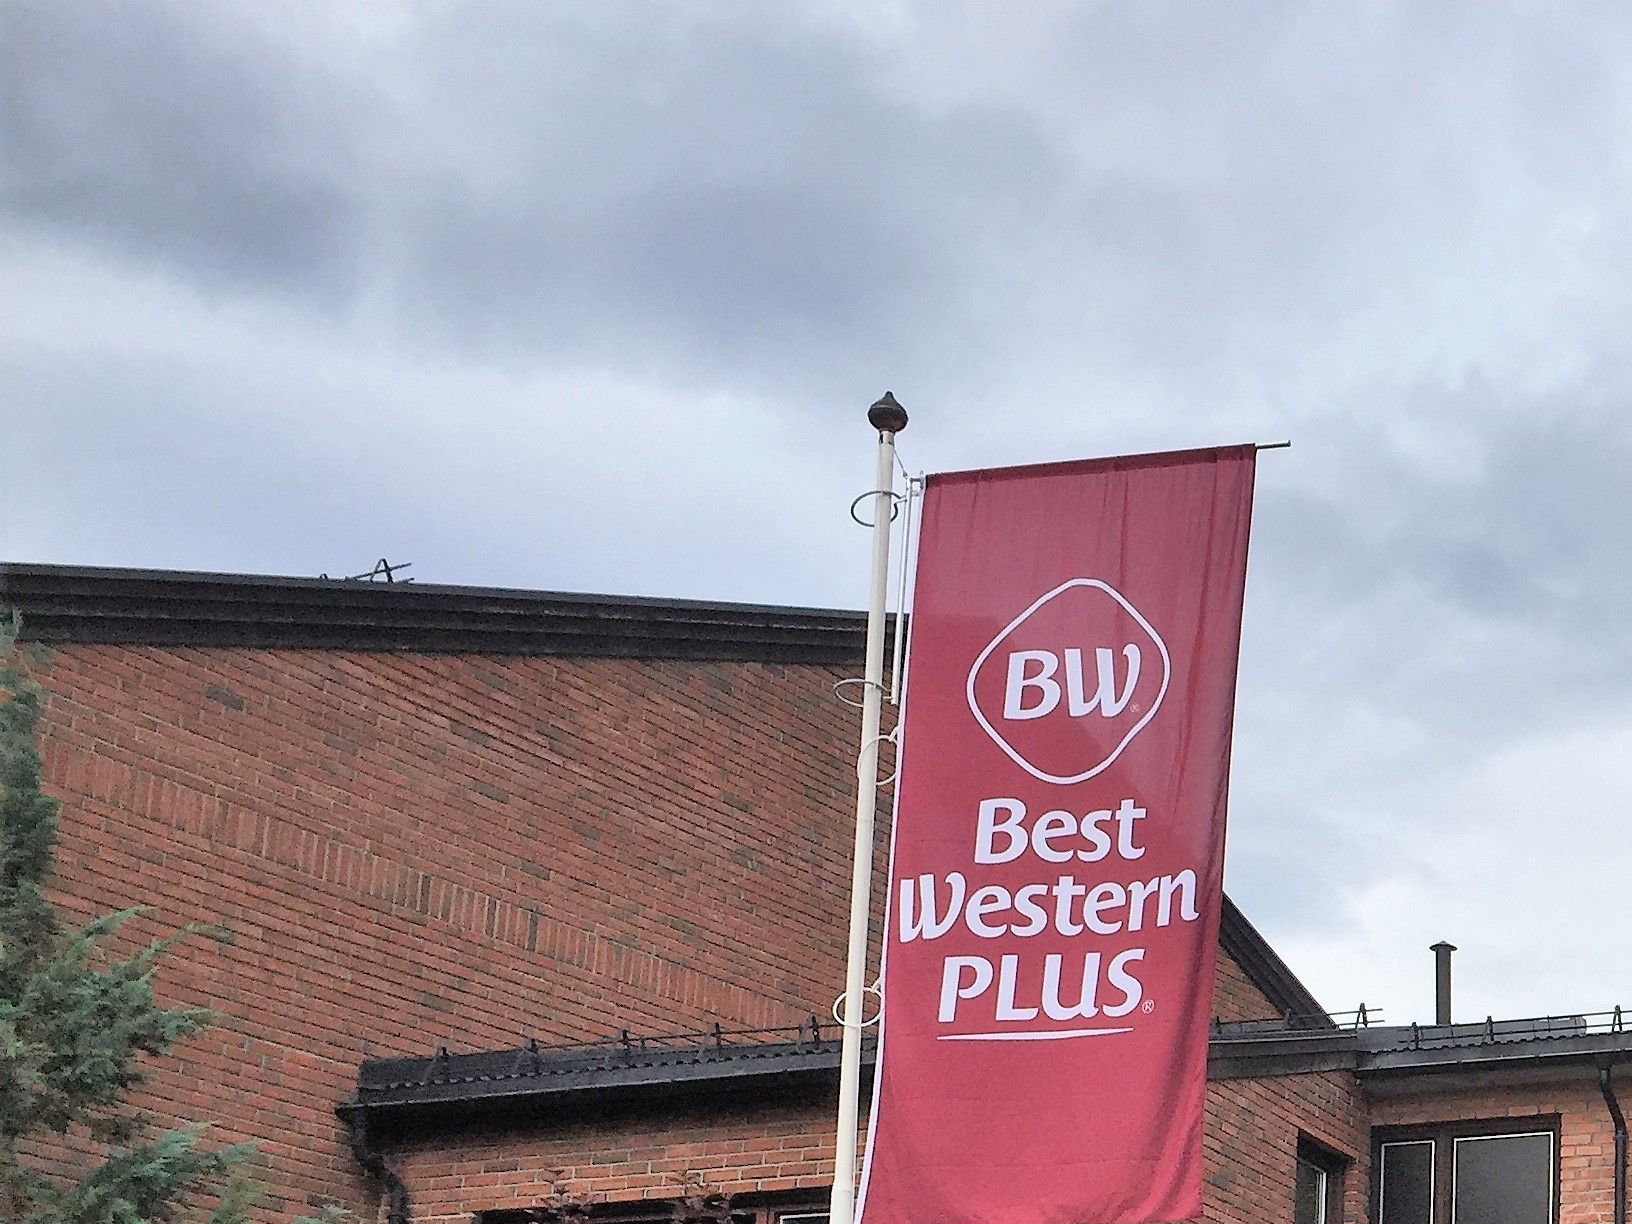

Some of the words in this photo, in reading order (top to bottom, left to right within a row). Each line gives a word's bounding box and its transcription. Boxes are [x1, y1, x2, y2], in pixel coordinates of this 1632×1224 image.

[1004, 644, 1141, 720] BW
[975, 797, 1147, 864] Best
[900, 870, 1200, 943] Western
[937, 948, 1145, 1023] PLUS
